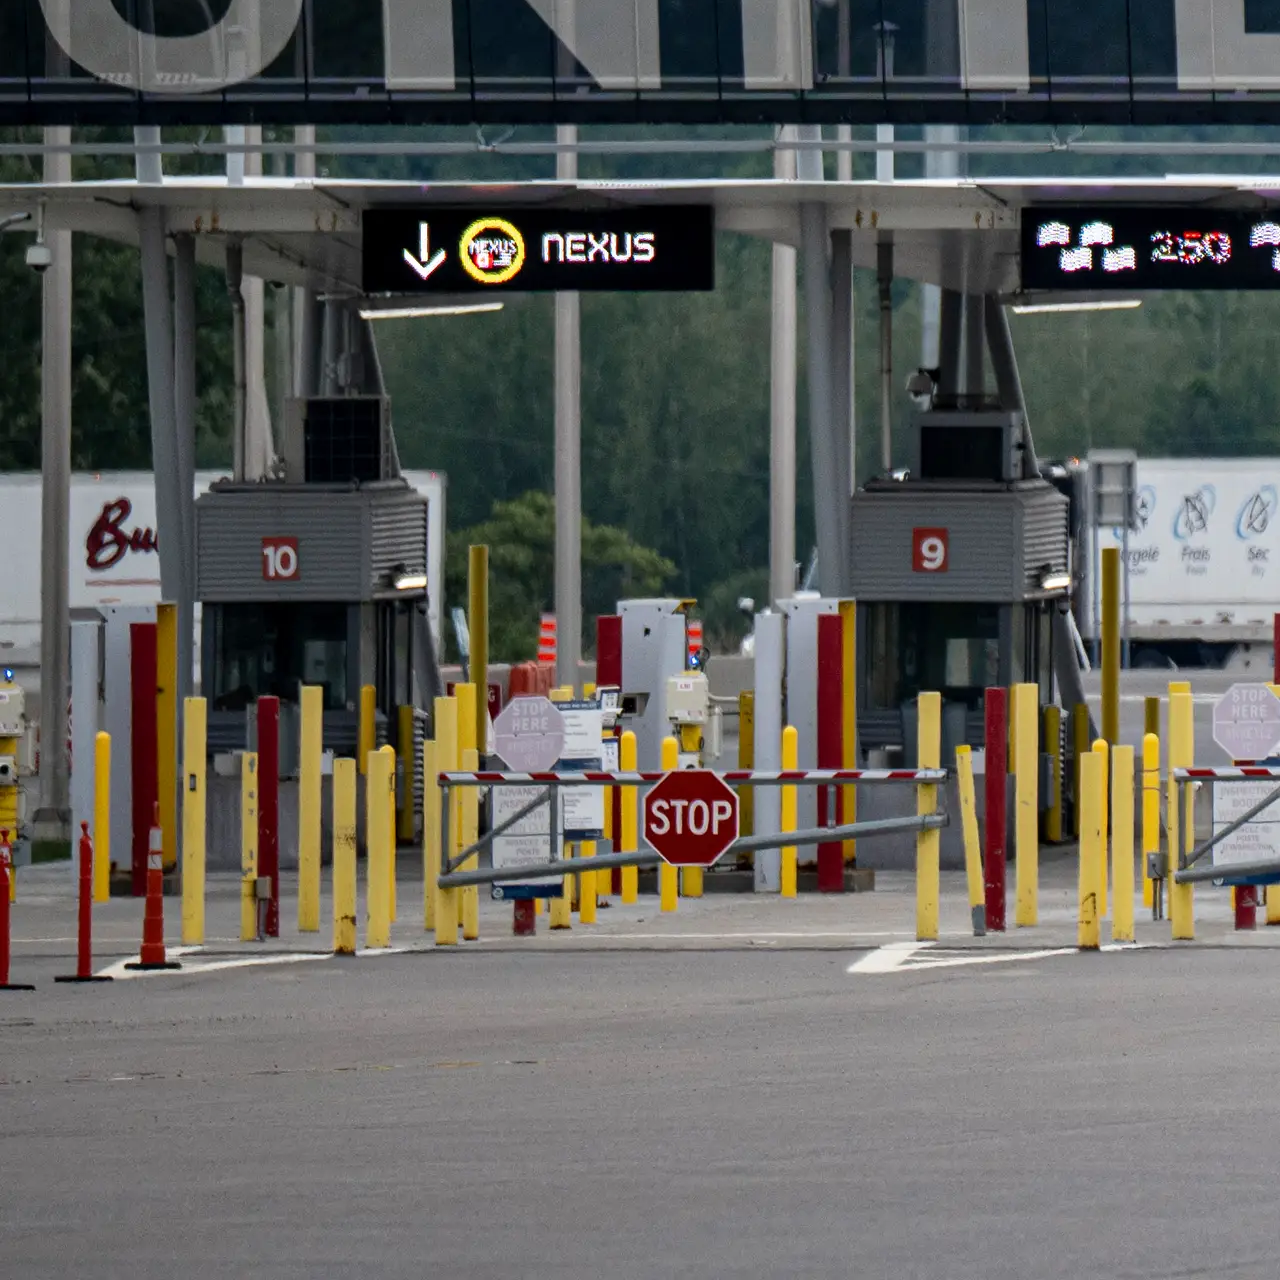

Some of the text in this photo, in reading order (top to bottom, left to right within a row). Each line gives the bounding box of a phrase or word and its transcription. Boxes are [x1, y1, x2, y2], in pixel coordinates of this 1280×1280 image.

[542, 232, 656, 262] NEXUS
[263, 545, 298, 577] 10
[921, 537, 945, 570] 9
[1181, 546, 1211, 561] Frais
[1247, 547, 1270, 562] Sec
[1232, 690, 1268, 703] STOP
[512, 703, 549, 716] STOP
[1231, 705, 1268, 718] HERE
[512, 717, 549, 731] HERE
[650, 799, 732, 835] STOP
